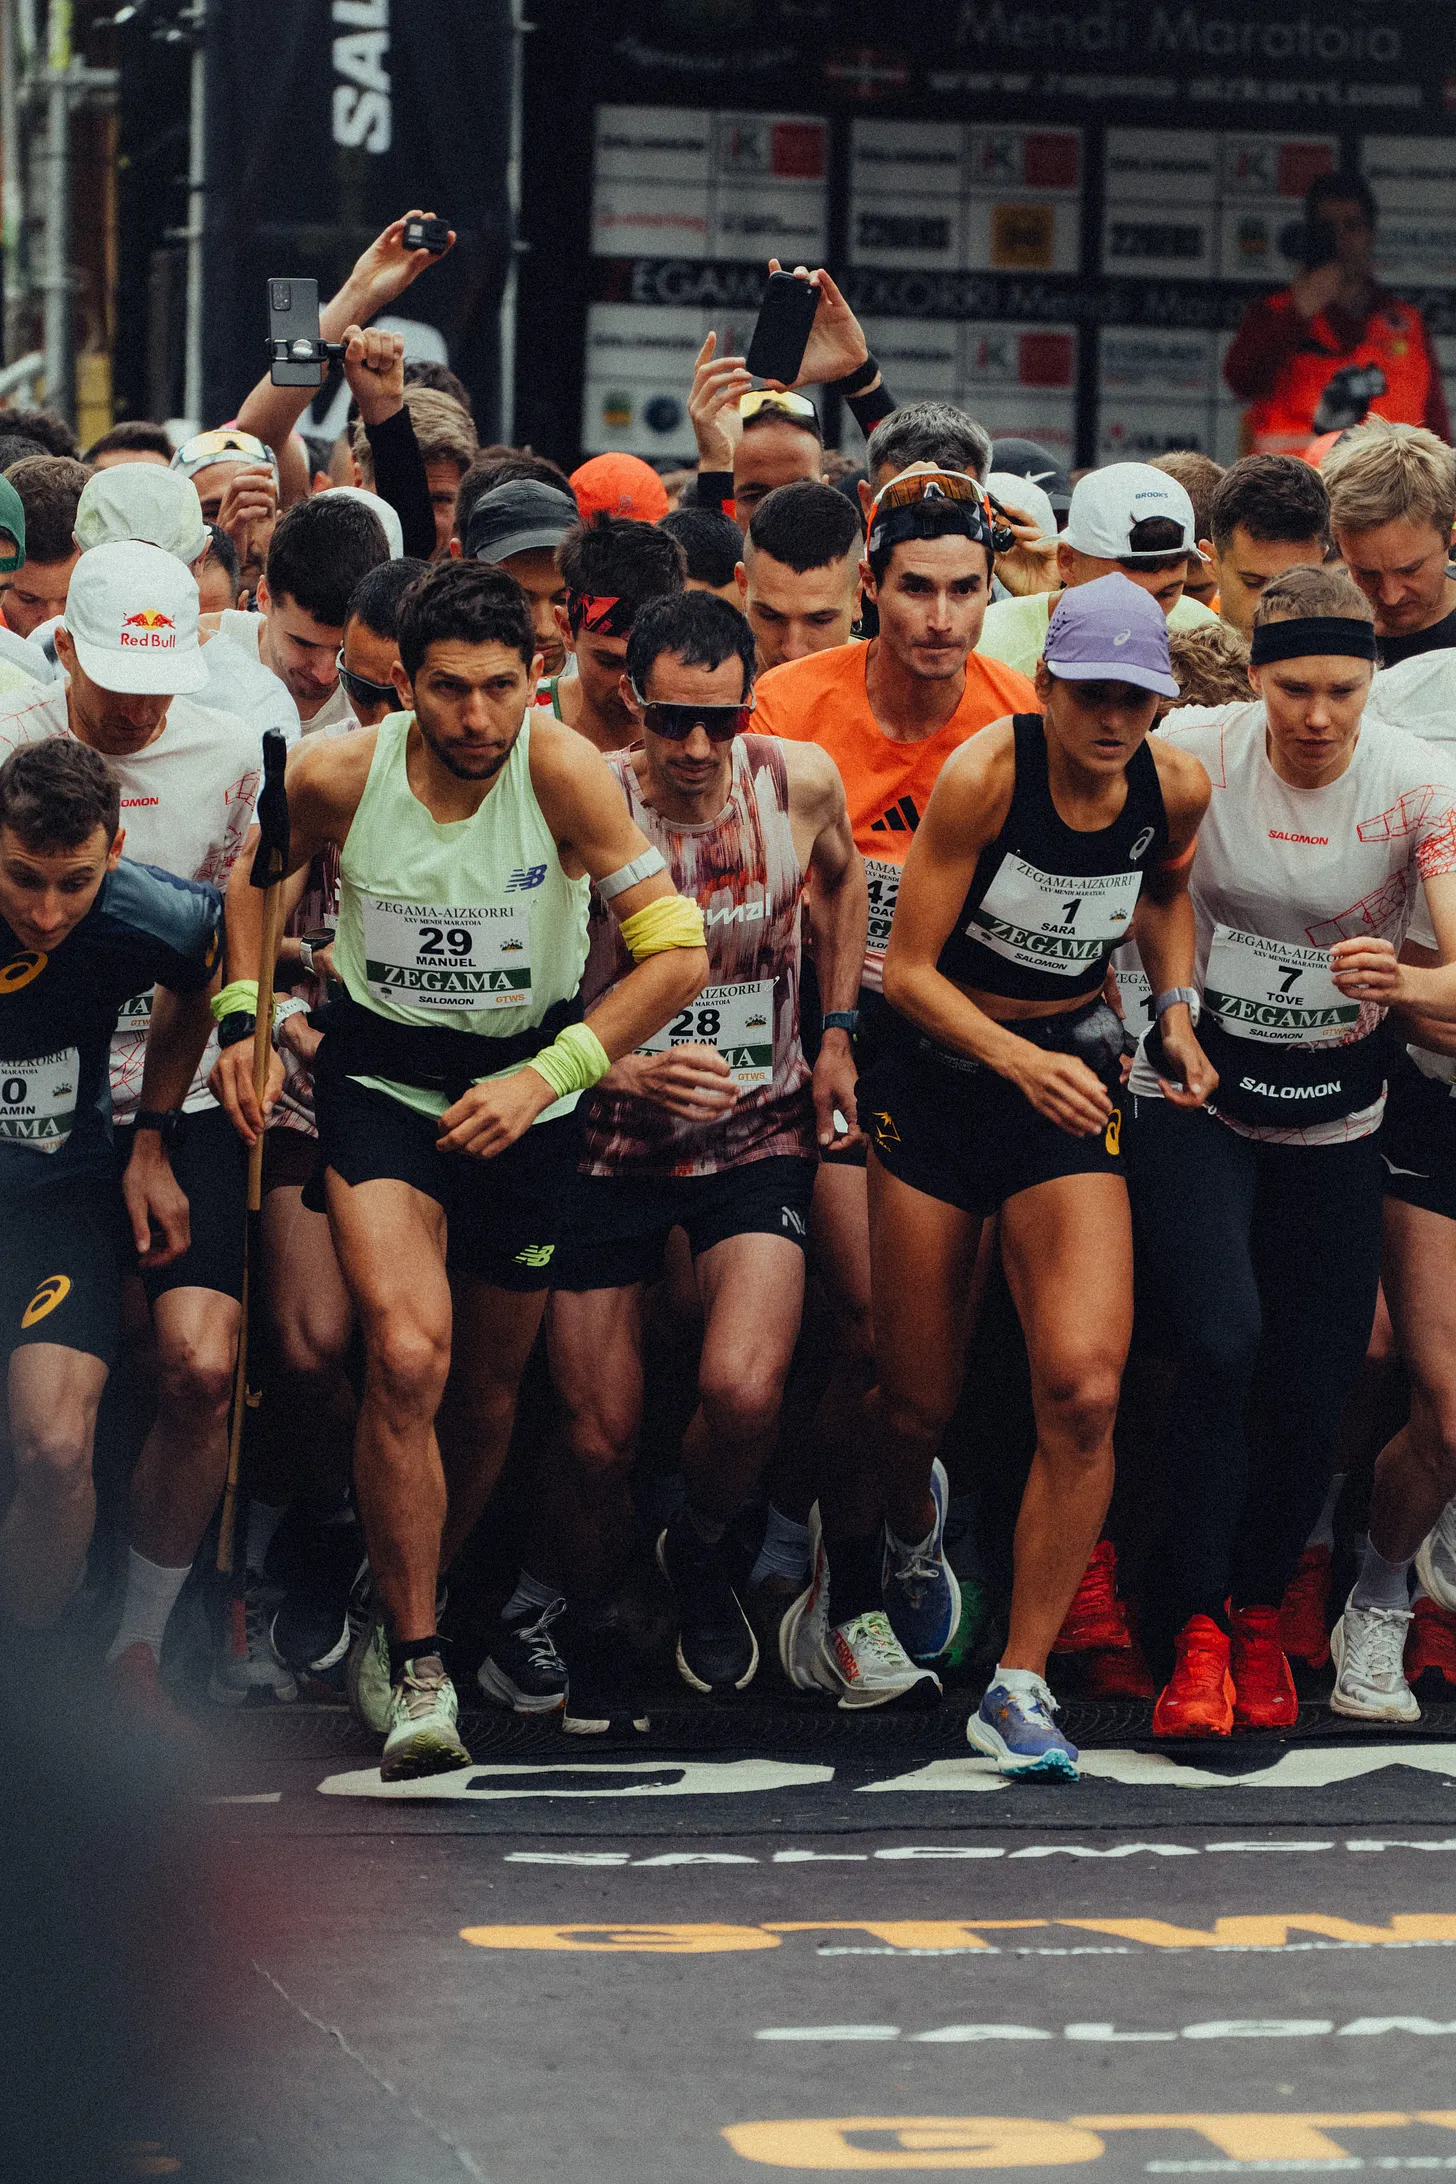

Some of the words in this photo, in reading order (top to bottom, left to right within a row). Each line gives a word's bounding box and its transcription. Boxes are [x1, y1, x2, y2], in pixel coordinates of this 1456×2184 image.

[333, 0, 391, 153] SAL
[1135, 491, 1168, 499] BROOKS
[121, 632, 149, 647] Red
[151, 634, 176, 648] Bull
[121, 796, 159, 807] OMON
[1268, 829, 1329, 845] SALOMON
[1017, 862, 1133, 889] ZEGAMA-AIZKORRI
[1039, 885, 1052, 893] XXV
[1054, 888, 1075, 896] MENDI
[376, 900, 514, 919] ZEGAMA-AIZKORRI
[1061, 898, 1082, 925] 1
[1040, 922, 1076, 935] SARA
[419, 927, 473, 956] 29
[989, 921, 1103, 960] ZEGAMA
[416, 956, 477, 967] MANUEL
[1014, 952, 1068, 970] SALOMON
[1253, 950, 1267, 958] XXV
[1268, 954, 1290, 964] MENDI
[1291, 958, 1328, 970] MARATOIA
[384, 965, 515, 992] ZEGAMA
[1278, 965, 1303, 993] 7
[419, 996, 475, 1005] SALOMON
[495, 994, 525, 1004] GTWS
[695, 999, 731, 1007] MARATOIA
[1266, 991, 1304, 1006] TOVE
[1218, 996, 1342, 1028] ZEGAMA
[668, 1008, 721, 1037] 28
[1249, 1028, 1304, 1039] SALOMON
[738, 1072, 766, 1081] GTWS
[1239, 1076, 1342, 1099] SALOMON
[721, 2111, 1456, 2171] GT
